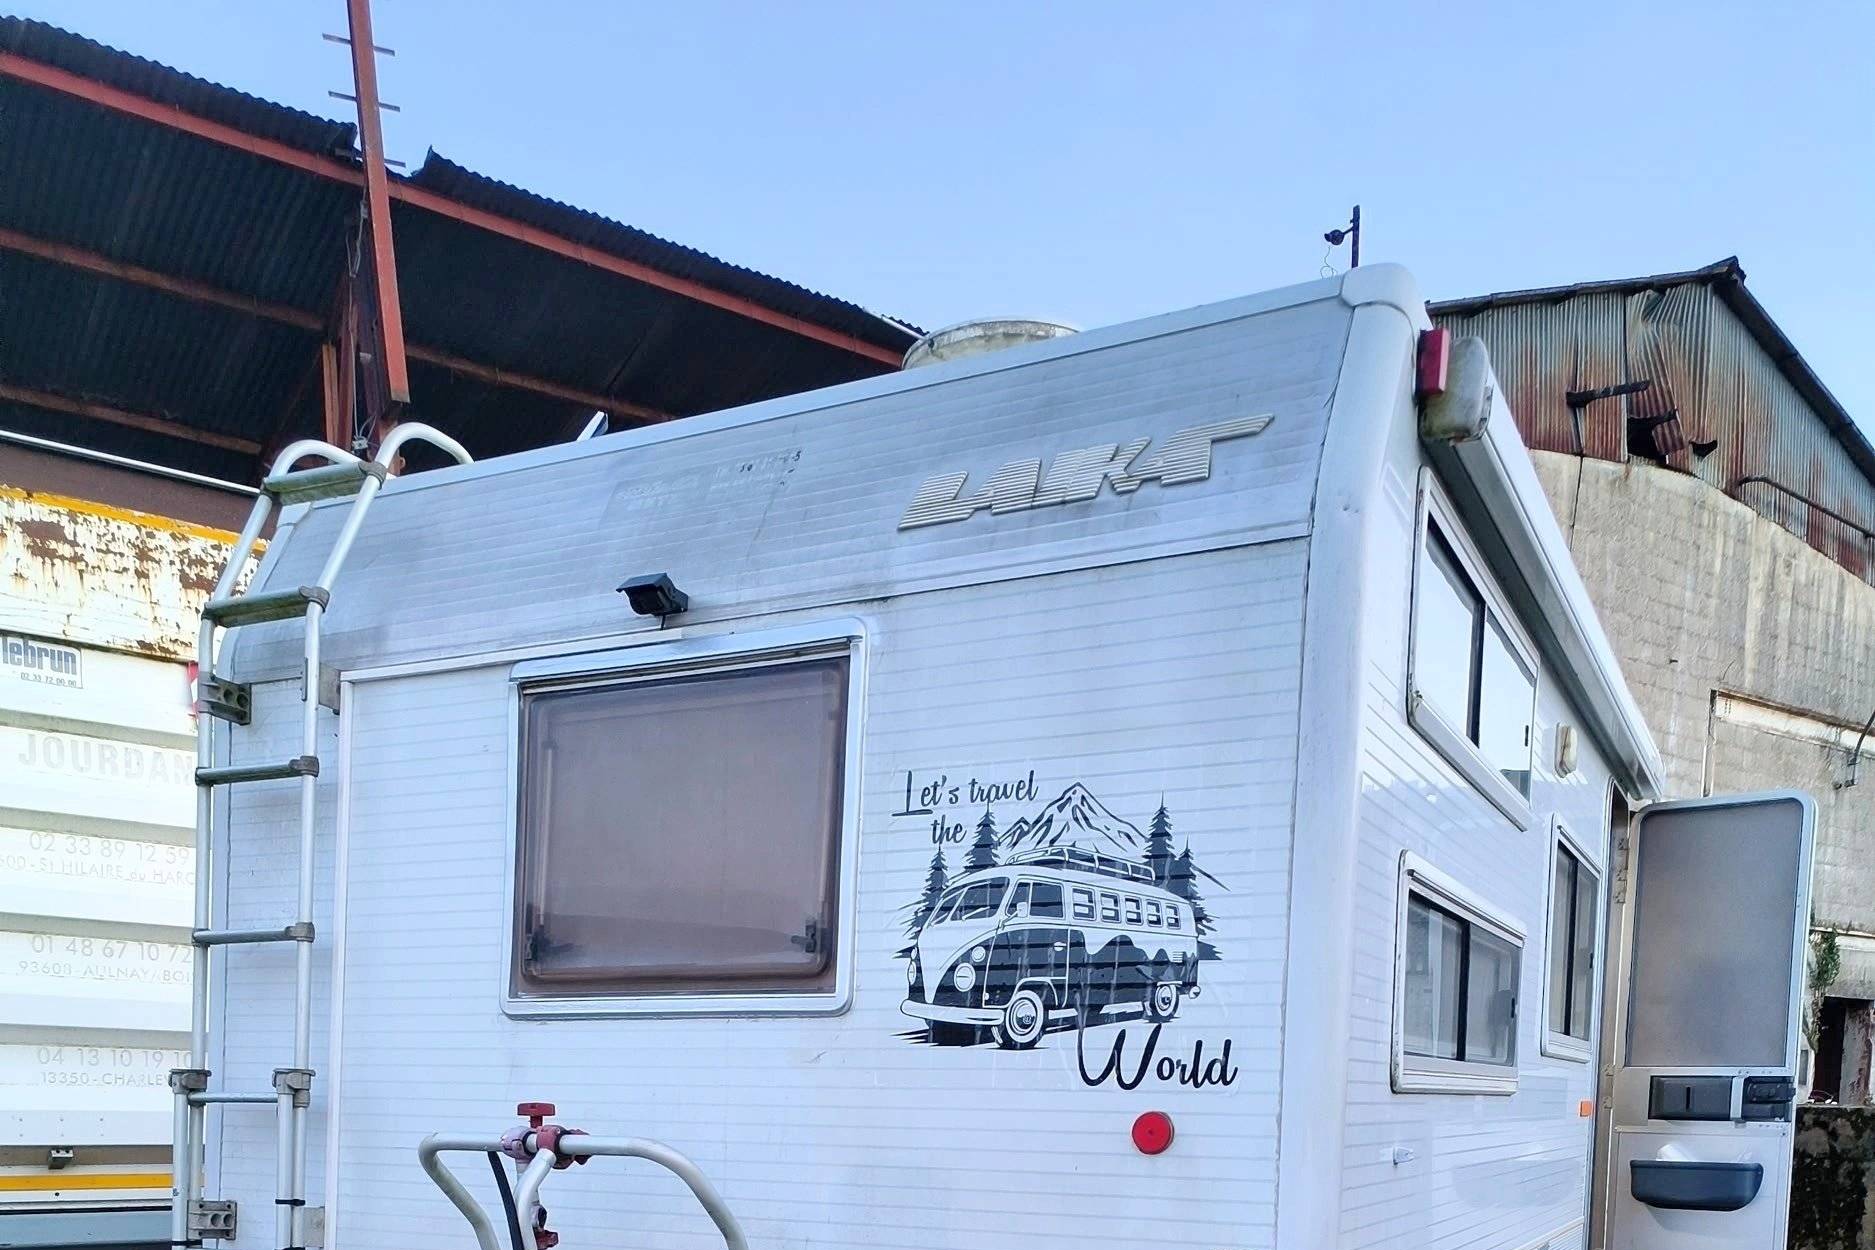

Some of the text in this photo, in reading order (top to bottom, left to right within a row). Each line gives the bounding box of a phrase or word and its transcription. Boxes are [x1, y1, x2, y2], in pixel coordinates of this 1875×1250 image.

[2, 636, 77, 676] lebrun
[892, 770, 1039, 816] Let's travel
[931, 814, 968, 845] the
[29, 831, 55, 852] 02
[64, 834, 91, 856] 33
[100, 838, 126, 859] 89
[31, 934, 55, 955] 01
[65, 937, 94, 957] 48
[102, 939, 128, 960] 67
[137, 941, 160, 962] 10
[37, 1047, 65, 1066] 04
[79, 1048, 101, 1067] 13
[112, 1049, 133, 1068] 10
[143, 1050, 164, 1069] 19
[1077, 1008, 1239, 1091] World
[41, 1071, 90, 1085] 13350
